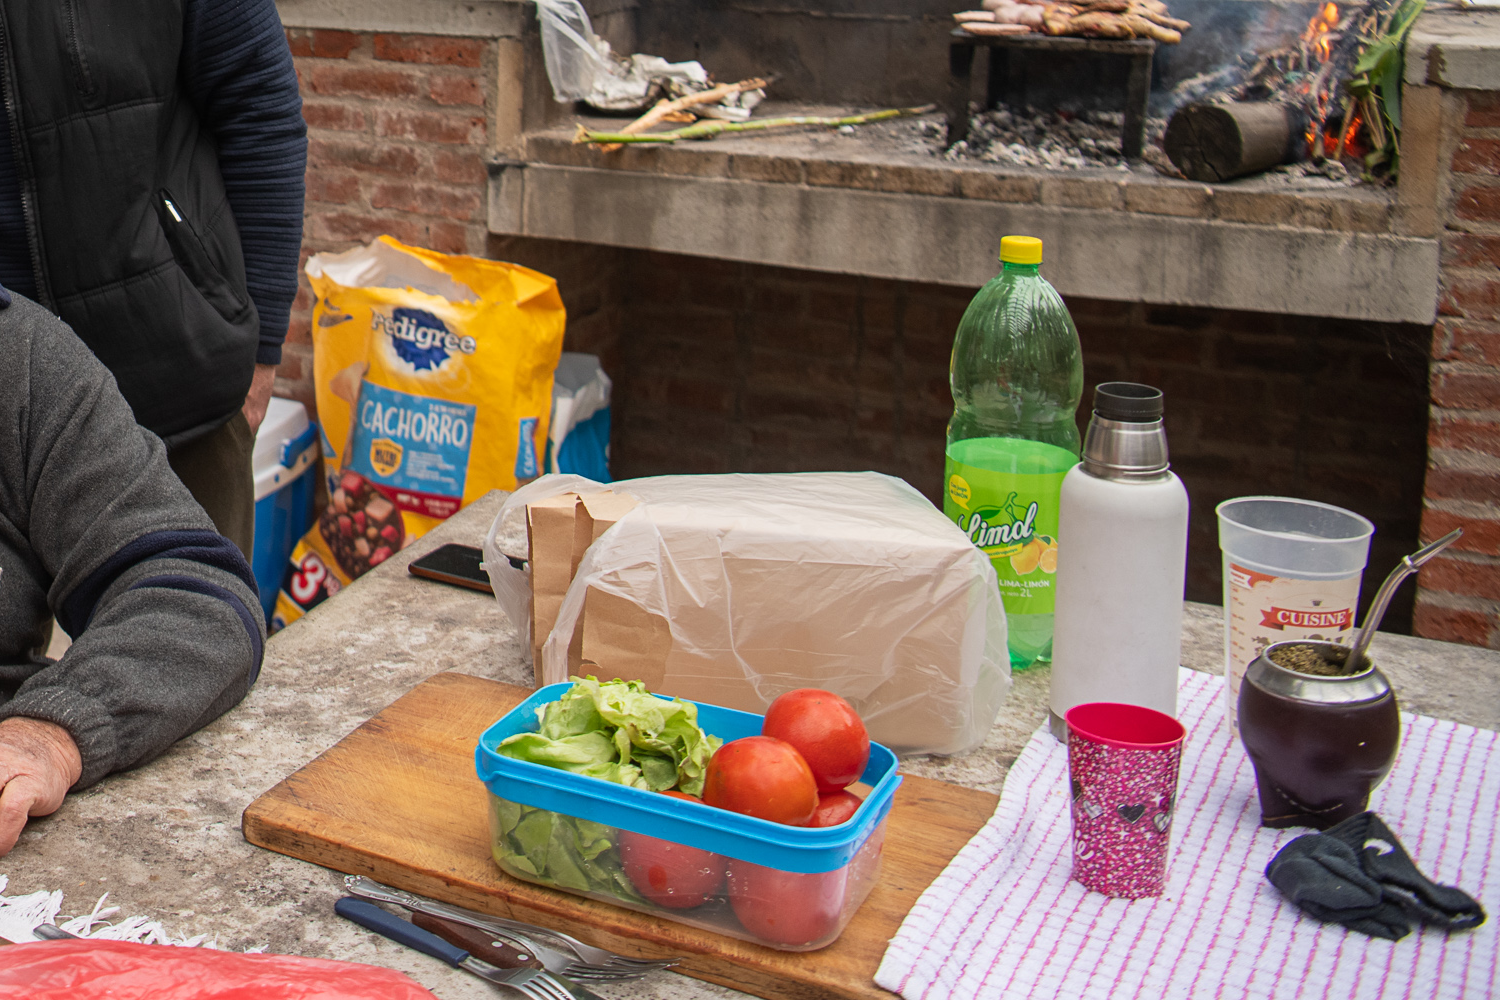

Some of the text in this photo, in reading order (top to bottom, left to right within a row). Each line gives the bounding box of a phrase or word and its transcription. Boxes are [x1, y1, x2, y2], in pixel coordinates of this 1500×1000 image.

[370, 309, 477, 355] Pedigree
[361, 399, 468, 447] CACHORRO
[290, 555, 326, 603] 3
[999, 579, 1050, 588] LIMA-LIMÓN
[1276, 609, 1347, 626] CUISINE
